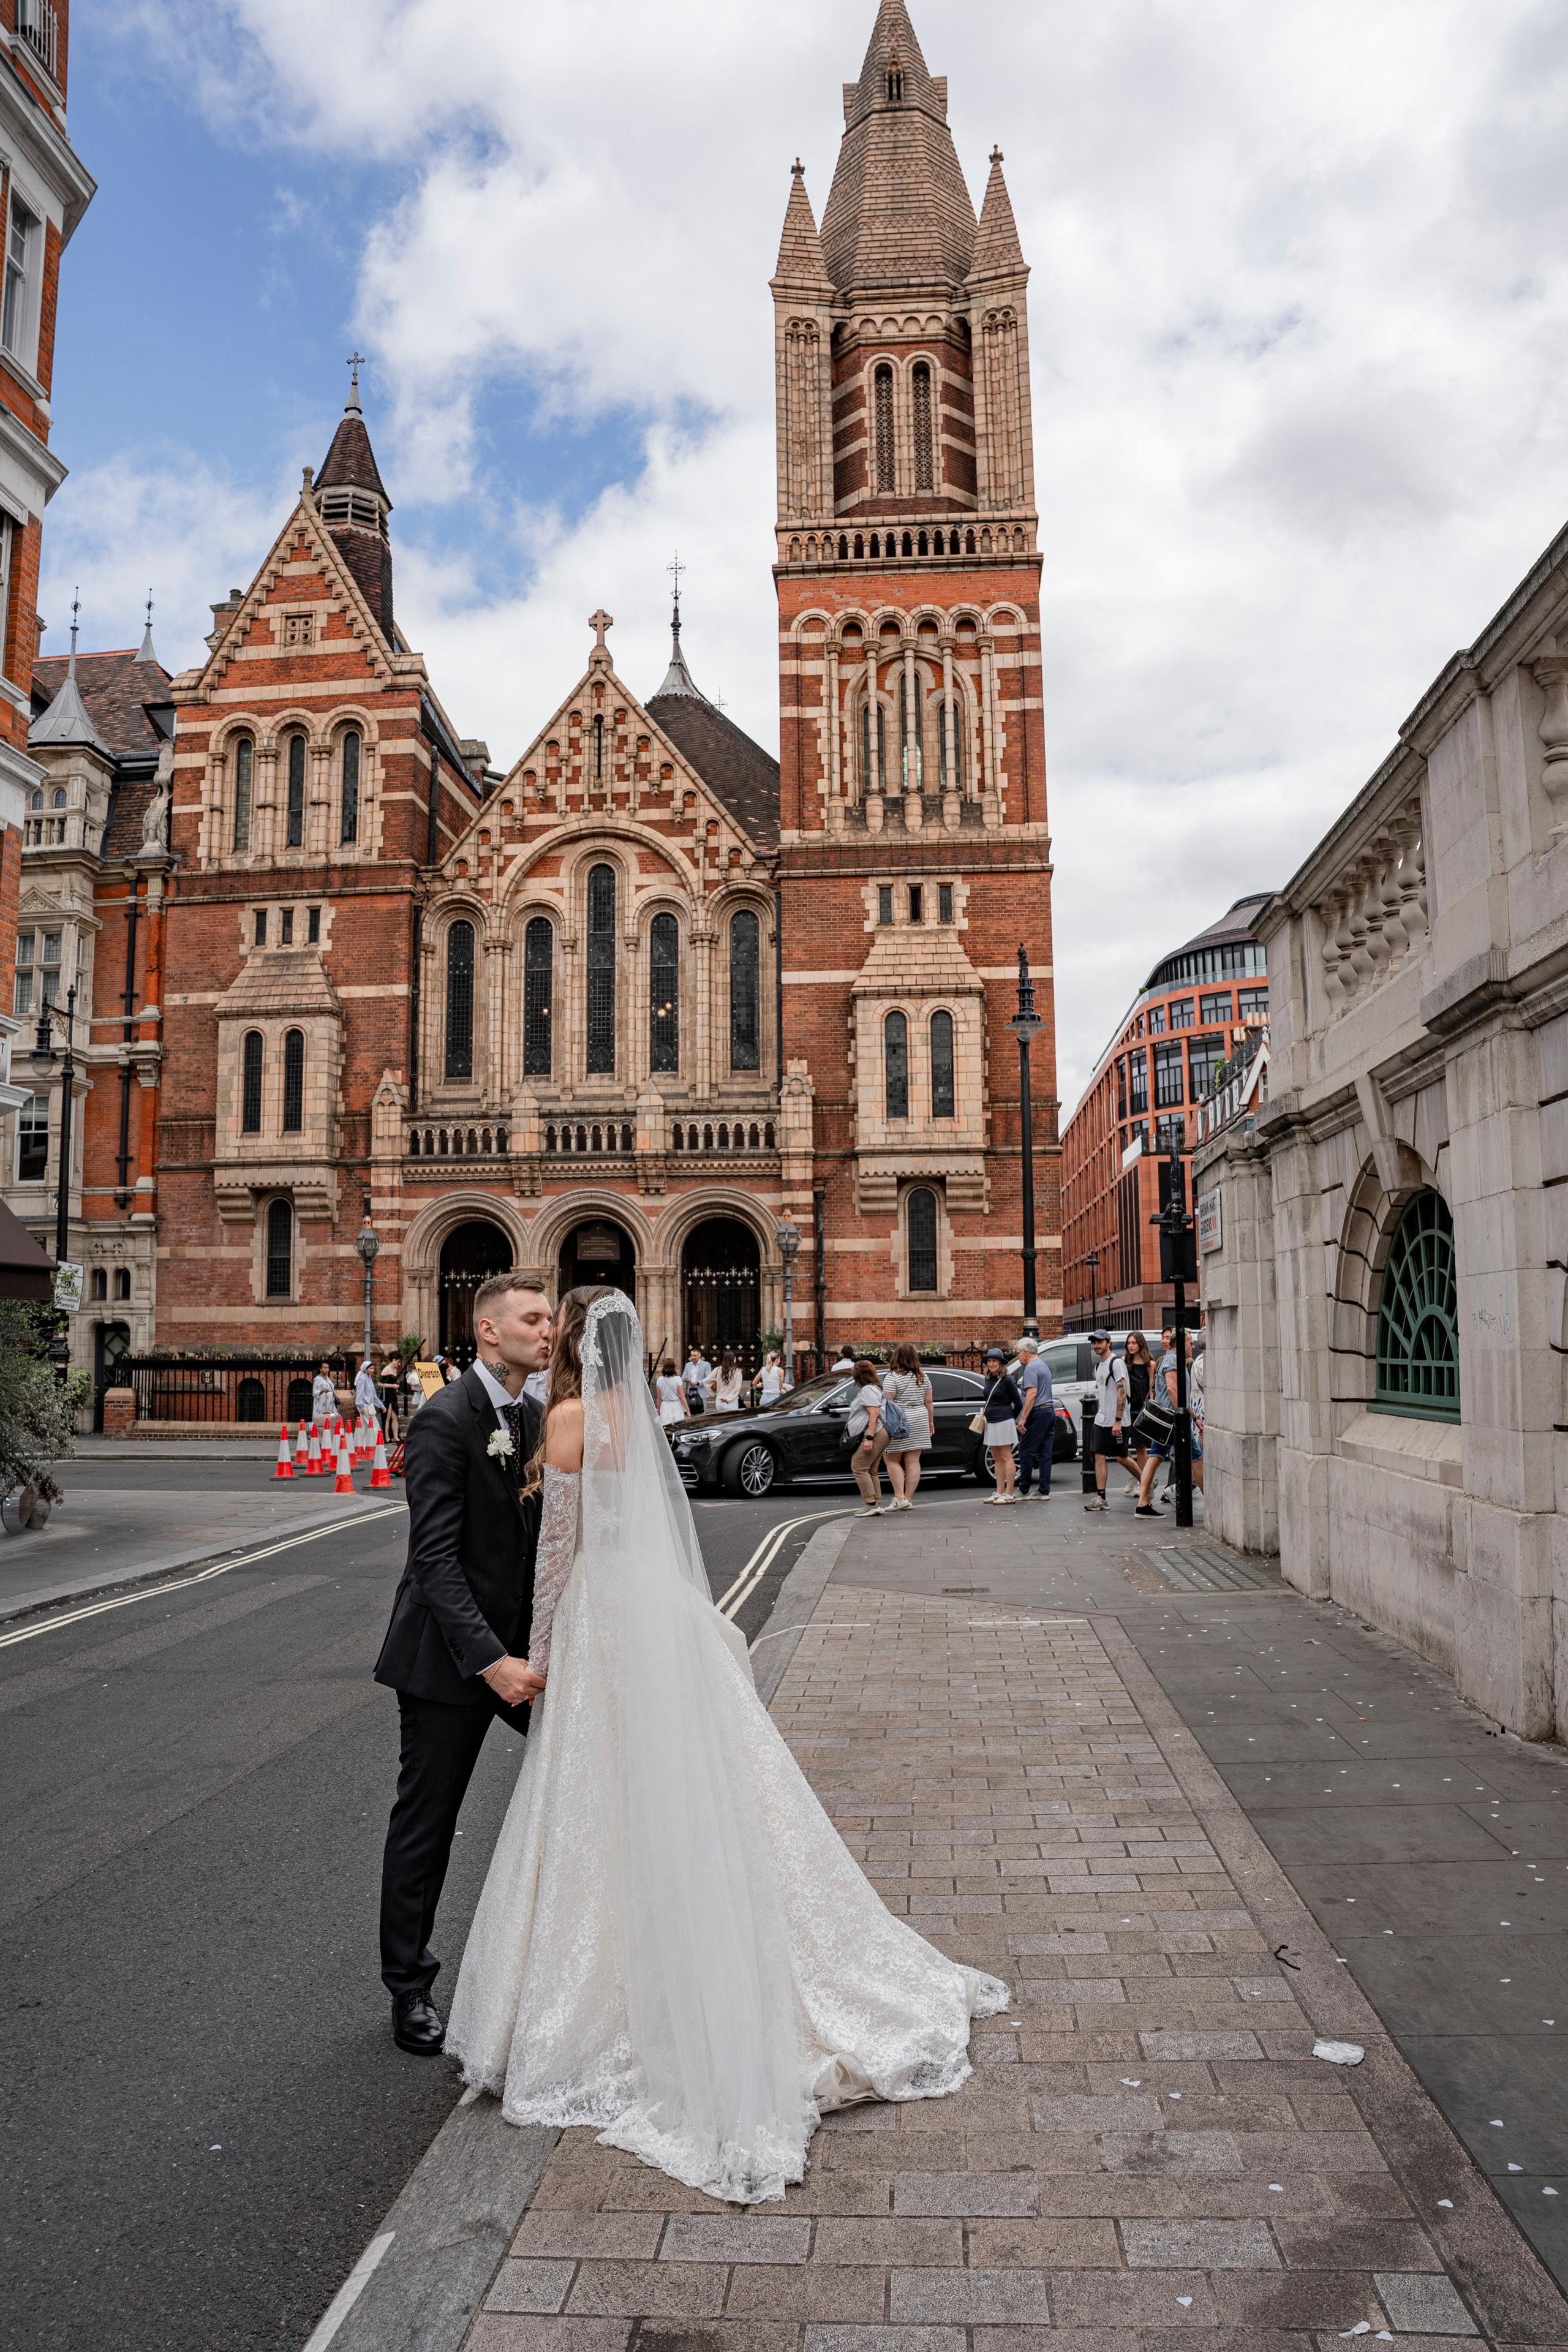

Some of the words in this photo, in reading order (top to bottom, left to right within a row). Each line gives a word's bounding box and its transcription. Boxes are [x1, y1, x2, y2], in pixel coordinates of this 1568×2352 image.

[1200, 1201, 1209, 1218] BROWN
[1200, 1217, 1212, 1235] GARDENS
[1212, 1215, 1216, 1229] W1
[417, 1368, 441, 1379] Diversion
